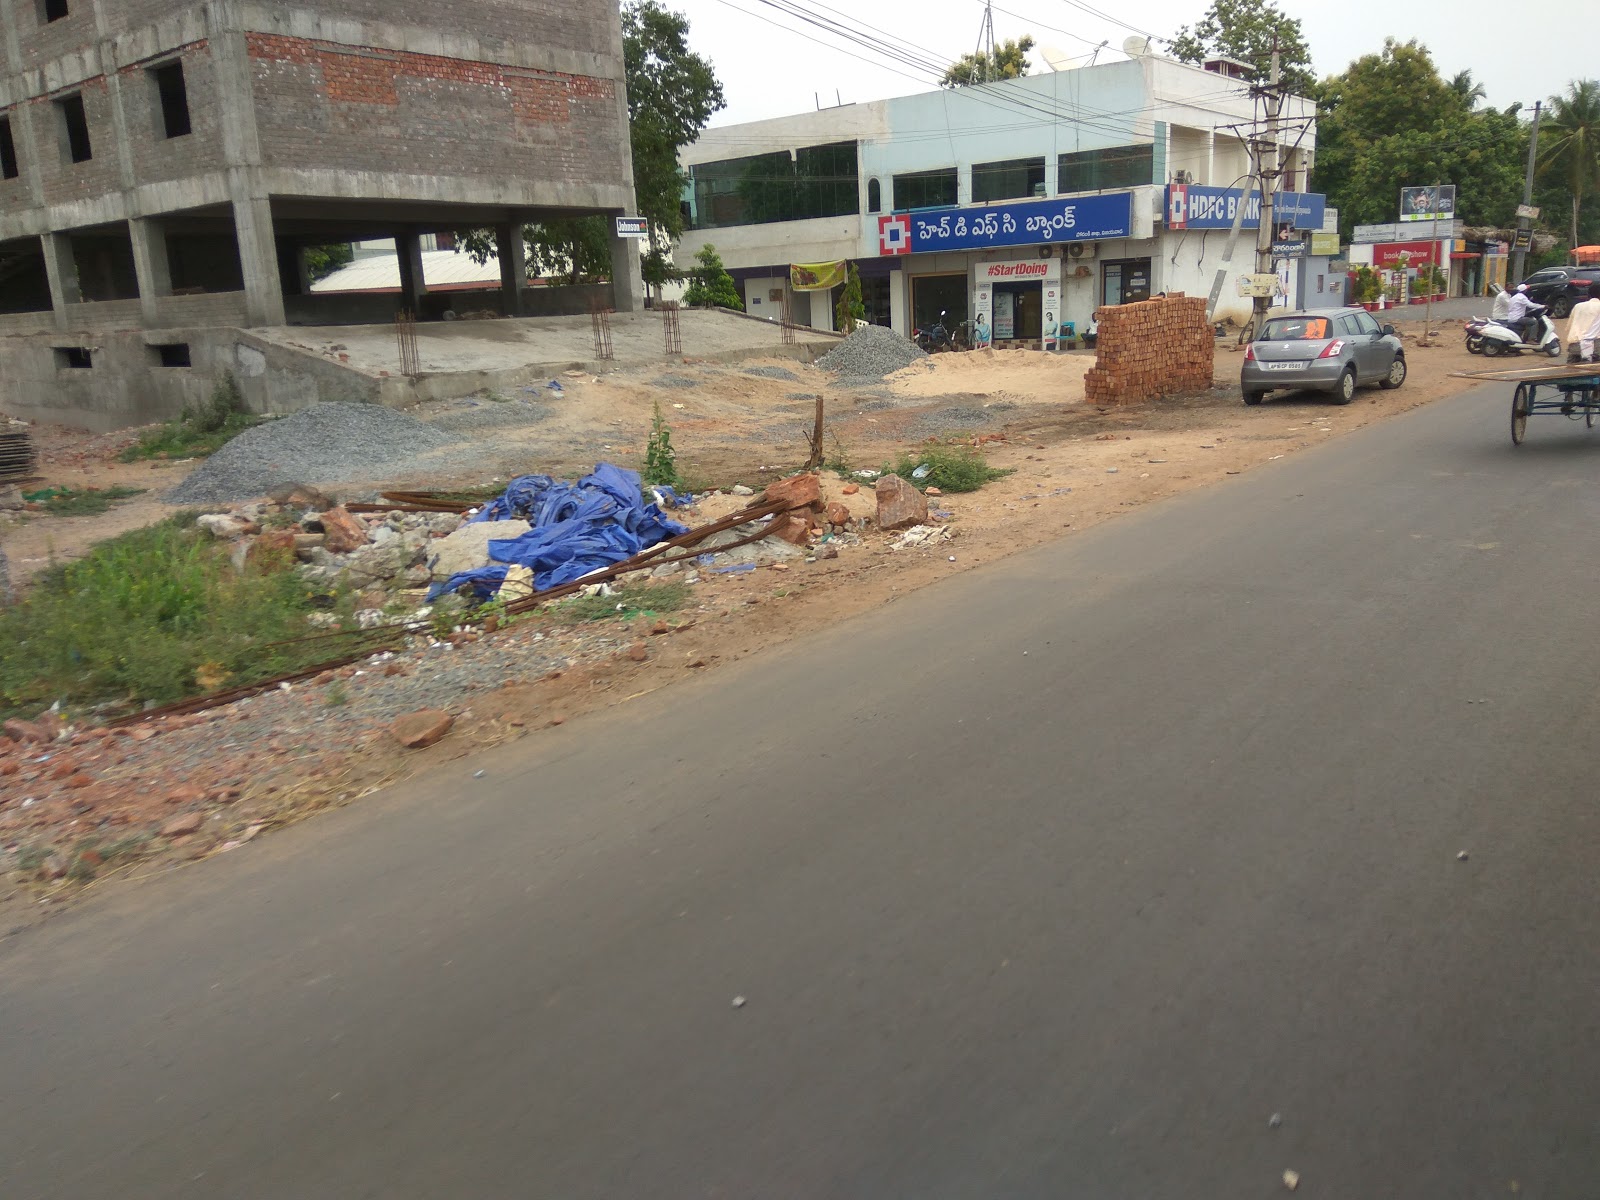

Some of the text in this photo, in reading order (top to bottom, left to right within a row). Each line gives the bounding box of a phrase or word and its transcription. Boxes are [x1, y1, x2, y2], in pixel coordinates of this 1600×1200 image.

[1190, 195, 1224, 220] HDFC
[618, 221, 641, 232] Johnson
[917, 206, 1076, 240] హెచ్ డి ఎఫ్ సి బ్యాంక్
[988, 263, 1048, 277] #StartDoing
